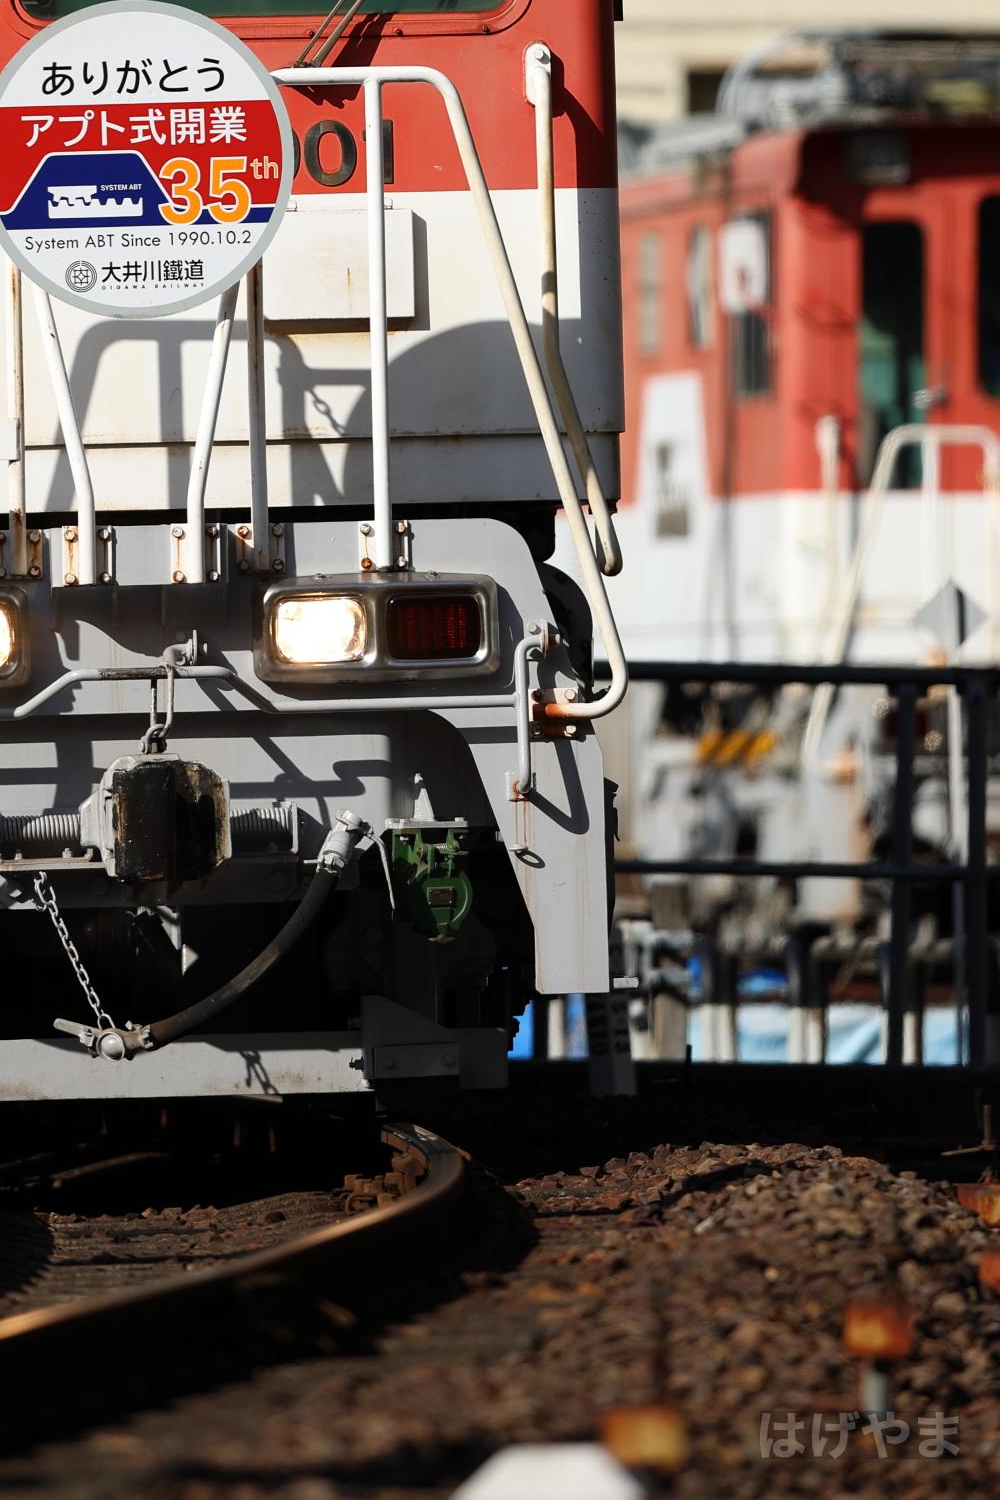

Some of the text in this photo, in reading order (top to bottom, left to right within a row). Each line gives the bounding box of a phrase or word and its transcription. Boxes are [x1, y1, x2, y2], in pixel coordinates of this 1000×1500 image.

[41, 57, 226, 96] ありがとう
[20, 106, 248, 148] アプト式開業
[158, 155, 279, 226] 35th
[25, 229, 252, 253] System ABT Since 1990.10.2
[101, 259, 205, 283] 大井川鐵道
[154, 282, 205, 290] RAILWAY
